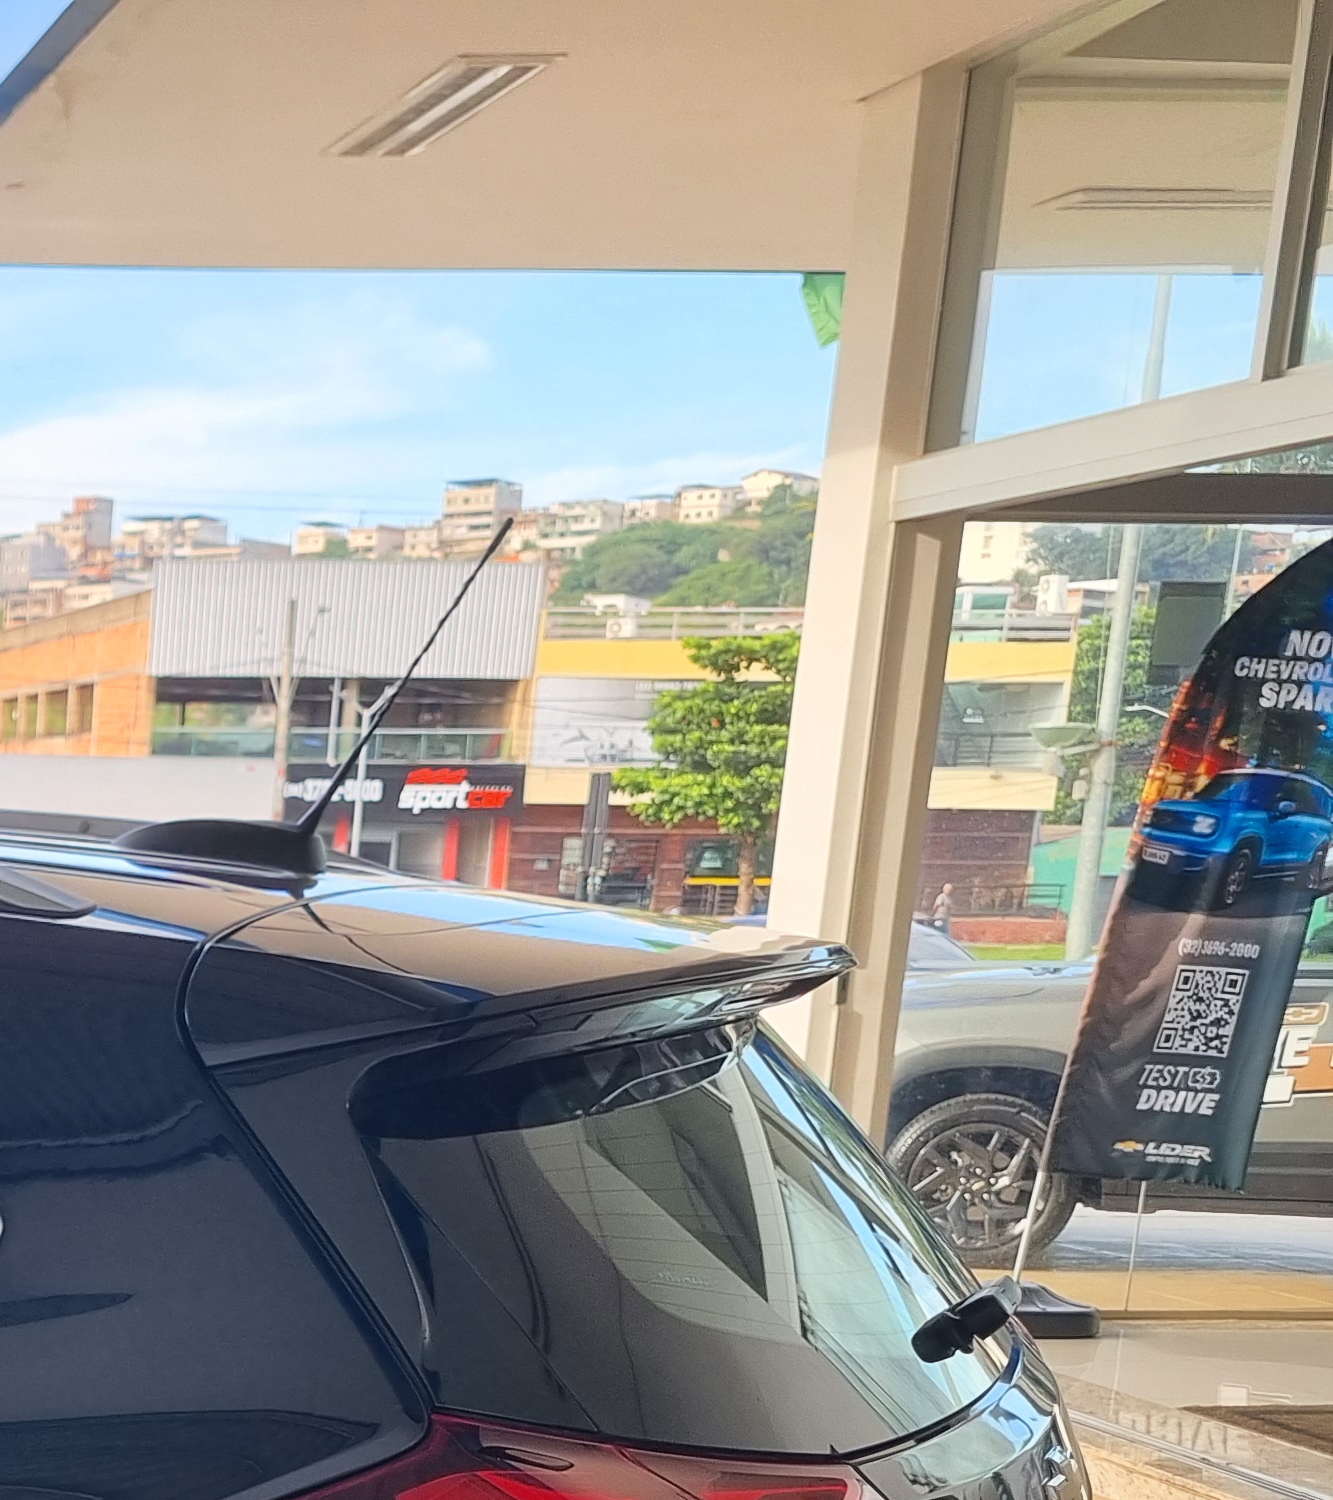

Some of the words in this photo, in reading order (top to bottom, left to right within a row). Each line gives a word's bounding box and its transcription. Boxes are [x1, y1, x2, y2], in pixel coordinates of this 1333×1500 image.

[1284, 629, 1333, 658] NO
[1139, 1064, 1188, 1087] TEST
[1136, 1089, 1220, 1116] DRIVE
